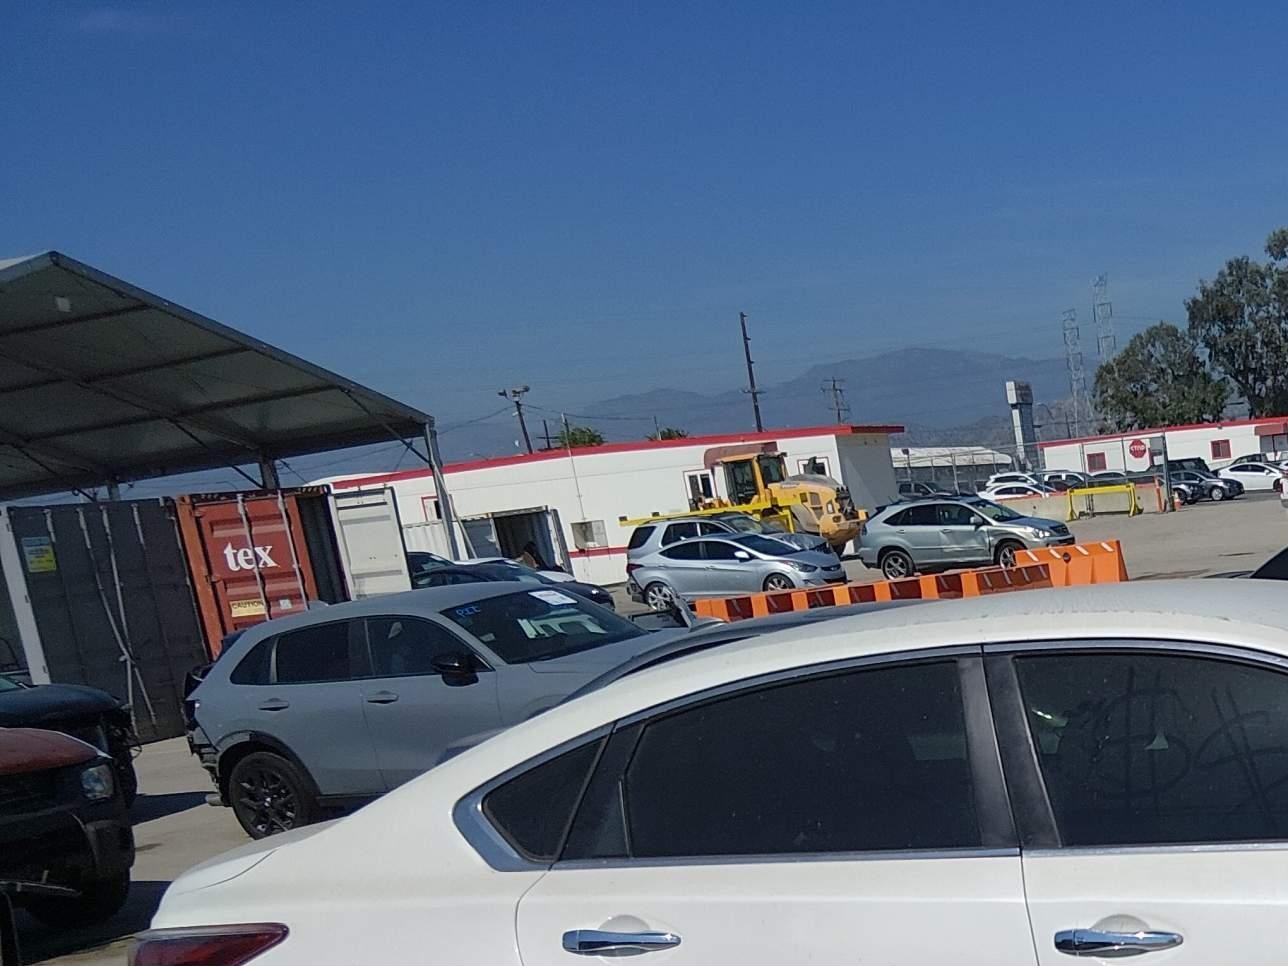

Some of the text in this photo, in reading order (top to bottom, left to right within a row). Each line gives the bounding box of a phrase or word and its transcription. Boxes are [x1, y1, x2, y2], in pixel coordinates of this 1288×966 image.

[1130, 444, 1146, 452] STOP
[223, 542, 281, 571] tex
[231, 600, 264, 610] CAUTION
